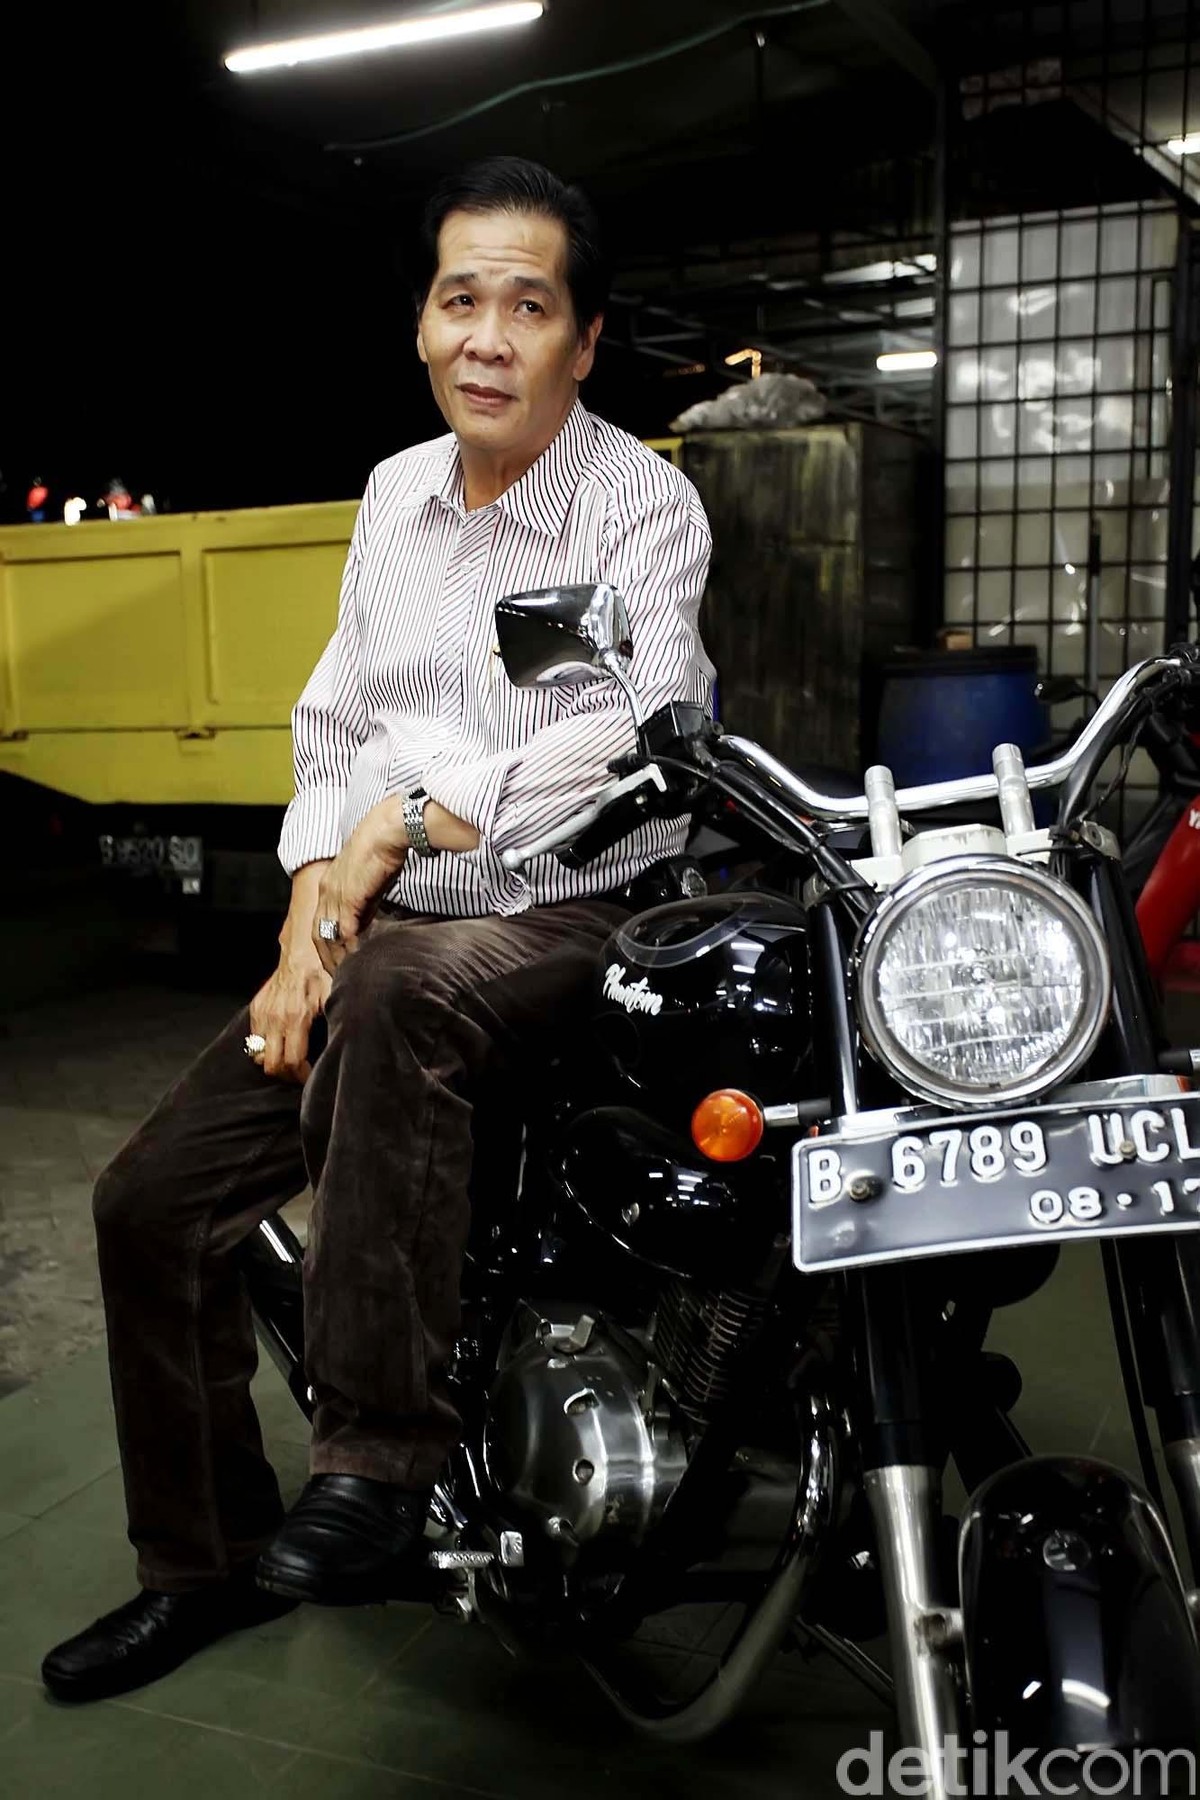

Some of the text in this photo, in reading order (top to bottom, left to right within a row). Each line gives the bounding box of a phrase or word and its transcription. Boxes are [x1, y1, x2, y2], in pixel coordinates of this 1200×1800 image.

[808, 1107, 1200, 1205] B 6789 UCL
